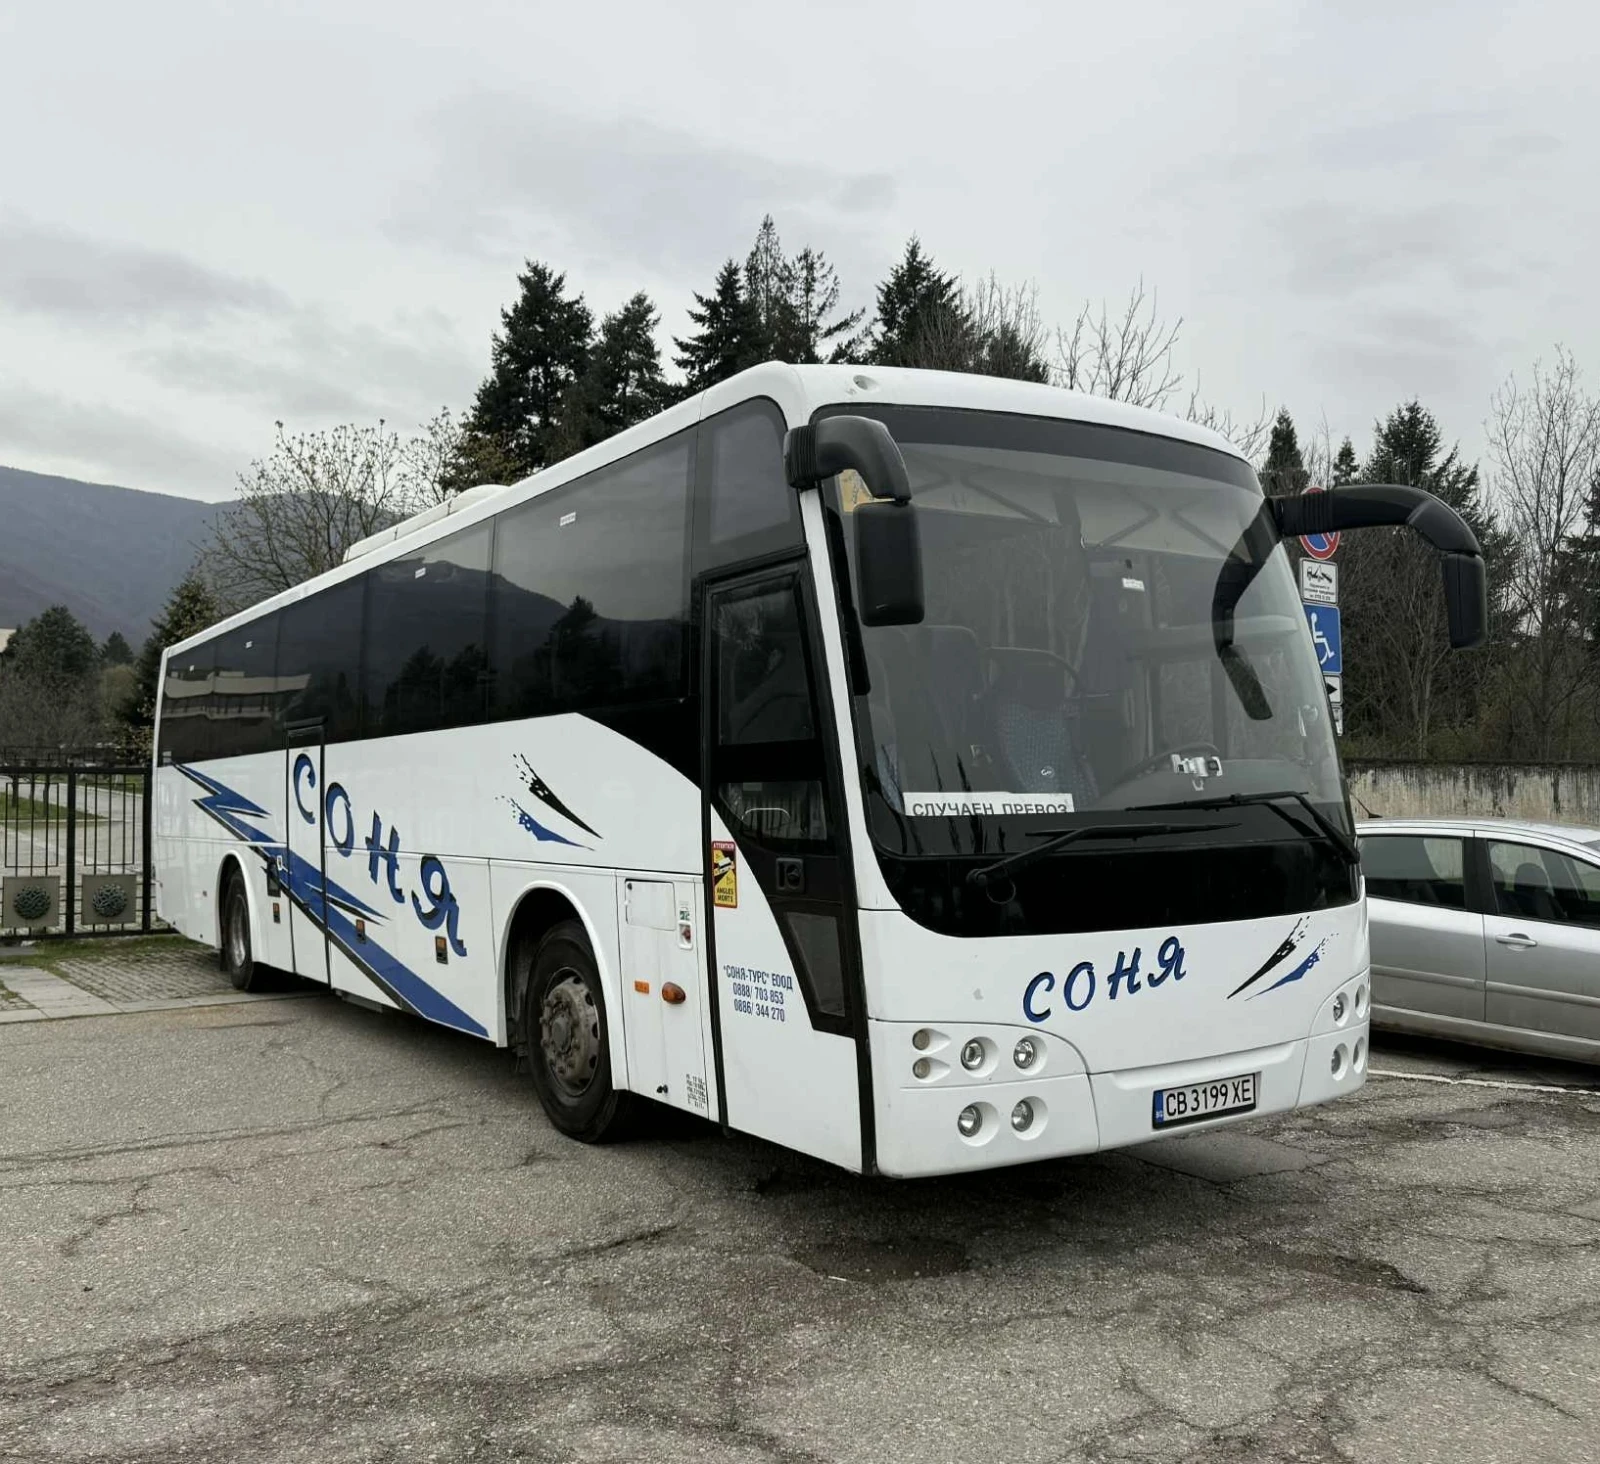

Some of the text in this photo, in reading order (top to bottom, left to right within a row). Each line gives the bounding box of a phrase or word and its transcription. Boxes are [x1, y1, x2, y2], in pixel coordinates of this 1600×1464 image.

[716, 887, 734, 895] ANGLES
[717, 894, 733, 903] MORTS
[771, 973, 793, 992] ЕООД
[732, 982, 785, 1005] 0888/ 703 853
[733, 998, 786, 1023] 0886/ 344 270
